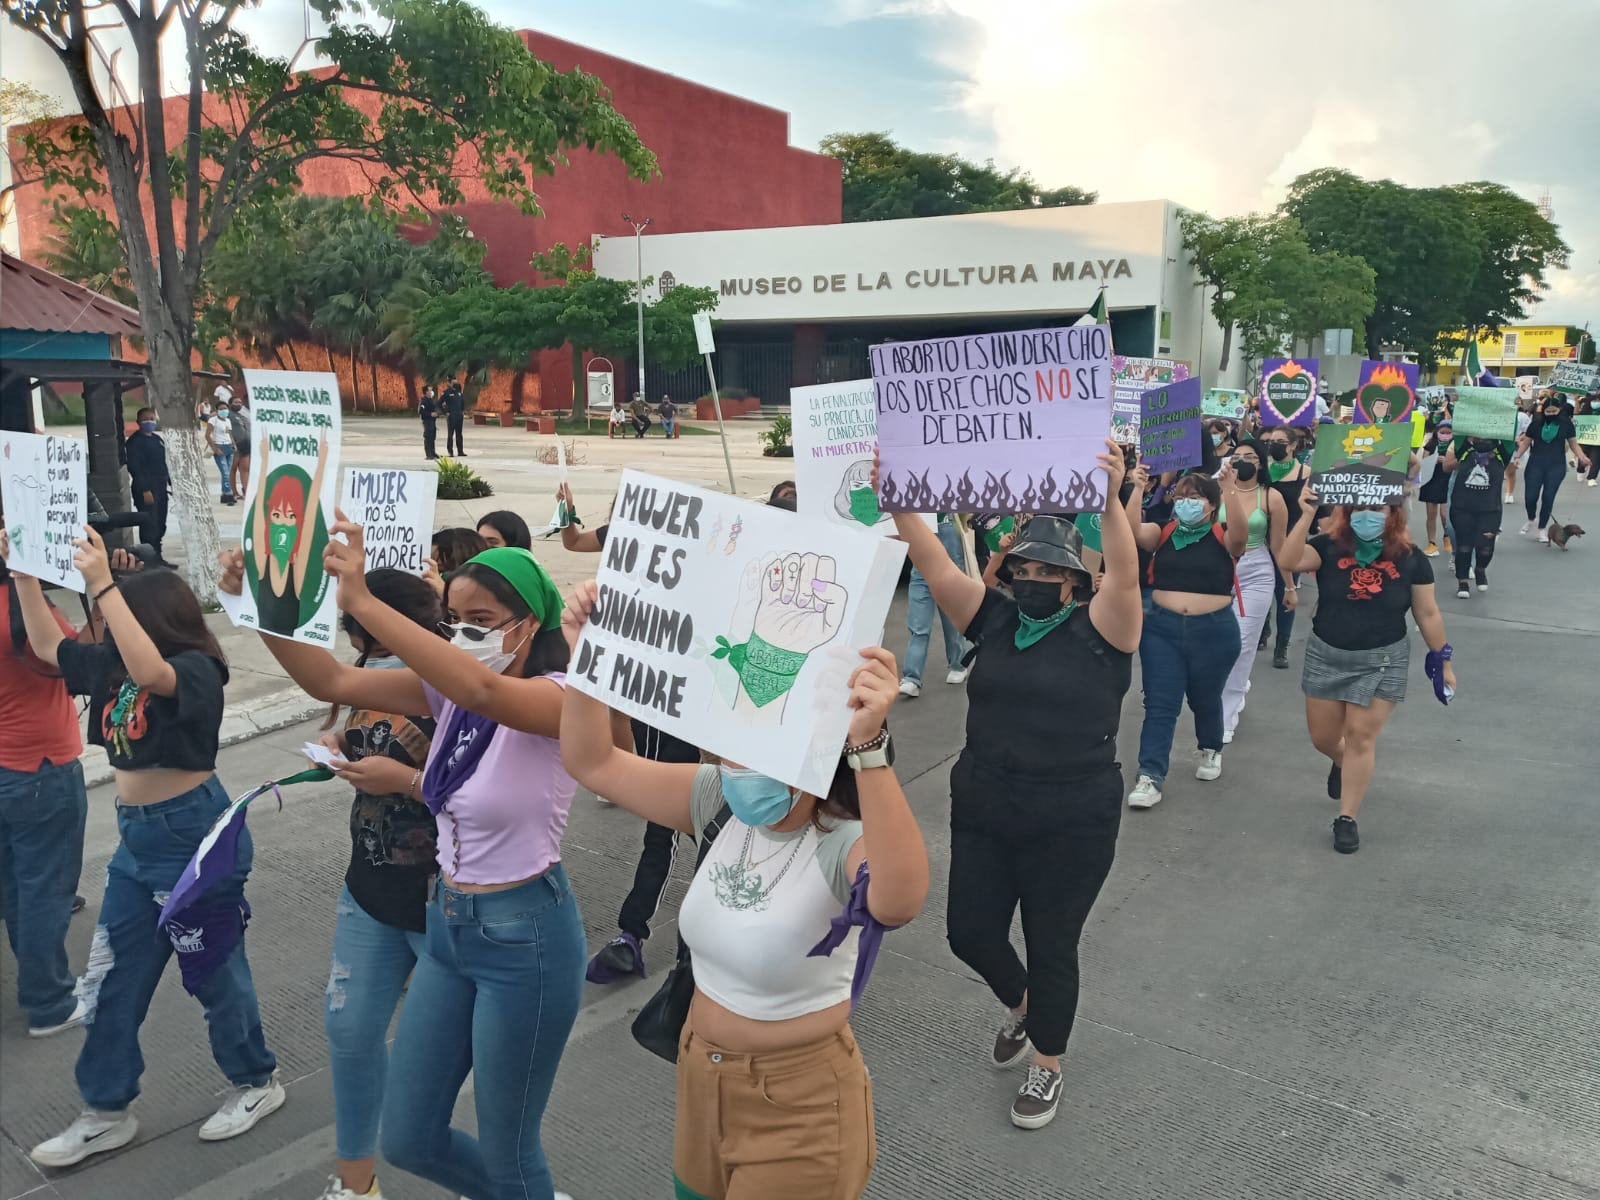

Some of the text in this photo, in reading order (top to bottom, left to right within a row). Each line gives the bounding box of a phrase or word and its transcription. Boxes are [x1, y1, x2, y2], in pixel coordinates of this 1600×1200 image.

[720, 259, 1132, 297] MUSEO DE LA CULTURA MAYA
[892, 340, 960, 375] ABORTO
[963, 336, 990, 371] ES
[990, 334, 1017, 368] UN
[1021, 328, 1109, 366] DERECHO.
[876, 365, 1106, 415] LOS DERECHOS NO SE
[810, 398, 821, 410] LA
[256, 408, 285, 423] ABORTO
[286, 411, 311, 426] LEGAL
[810, 414, 821, 427] SU
[923, 411, 1043, 446] DEBATEN.
[46, 436, 81, 464] El aborto
[269, 434, 284, 452] NO
[812, 441, 871, 458] NI MUERTAS
[47, 468, 70, 482] es una
[1320, 473, 1382, 485] TODO ESTE
[50, 485, 79, 507] decisión
[1311, 483, 1403, 497] MALDITO SISTEMA
[1322, 493, 1387, 505] ESTA MAL
[365, 504, 396, 522] no es
[620, 482, 703, 540] MUJER
[45, 530, 53, 544] no
[54, 532, 63, 545] un
[365, 544, 424, 571] MADRE!
[606, 536, 687, 590] NO ES
[589, 583, 693, 656] SINÓNIMO
[575, 638, 687, 719] DE MADRE
